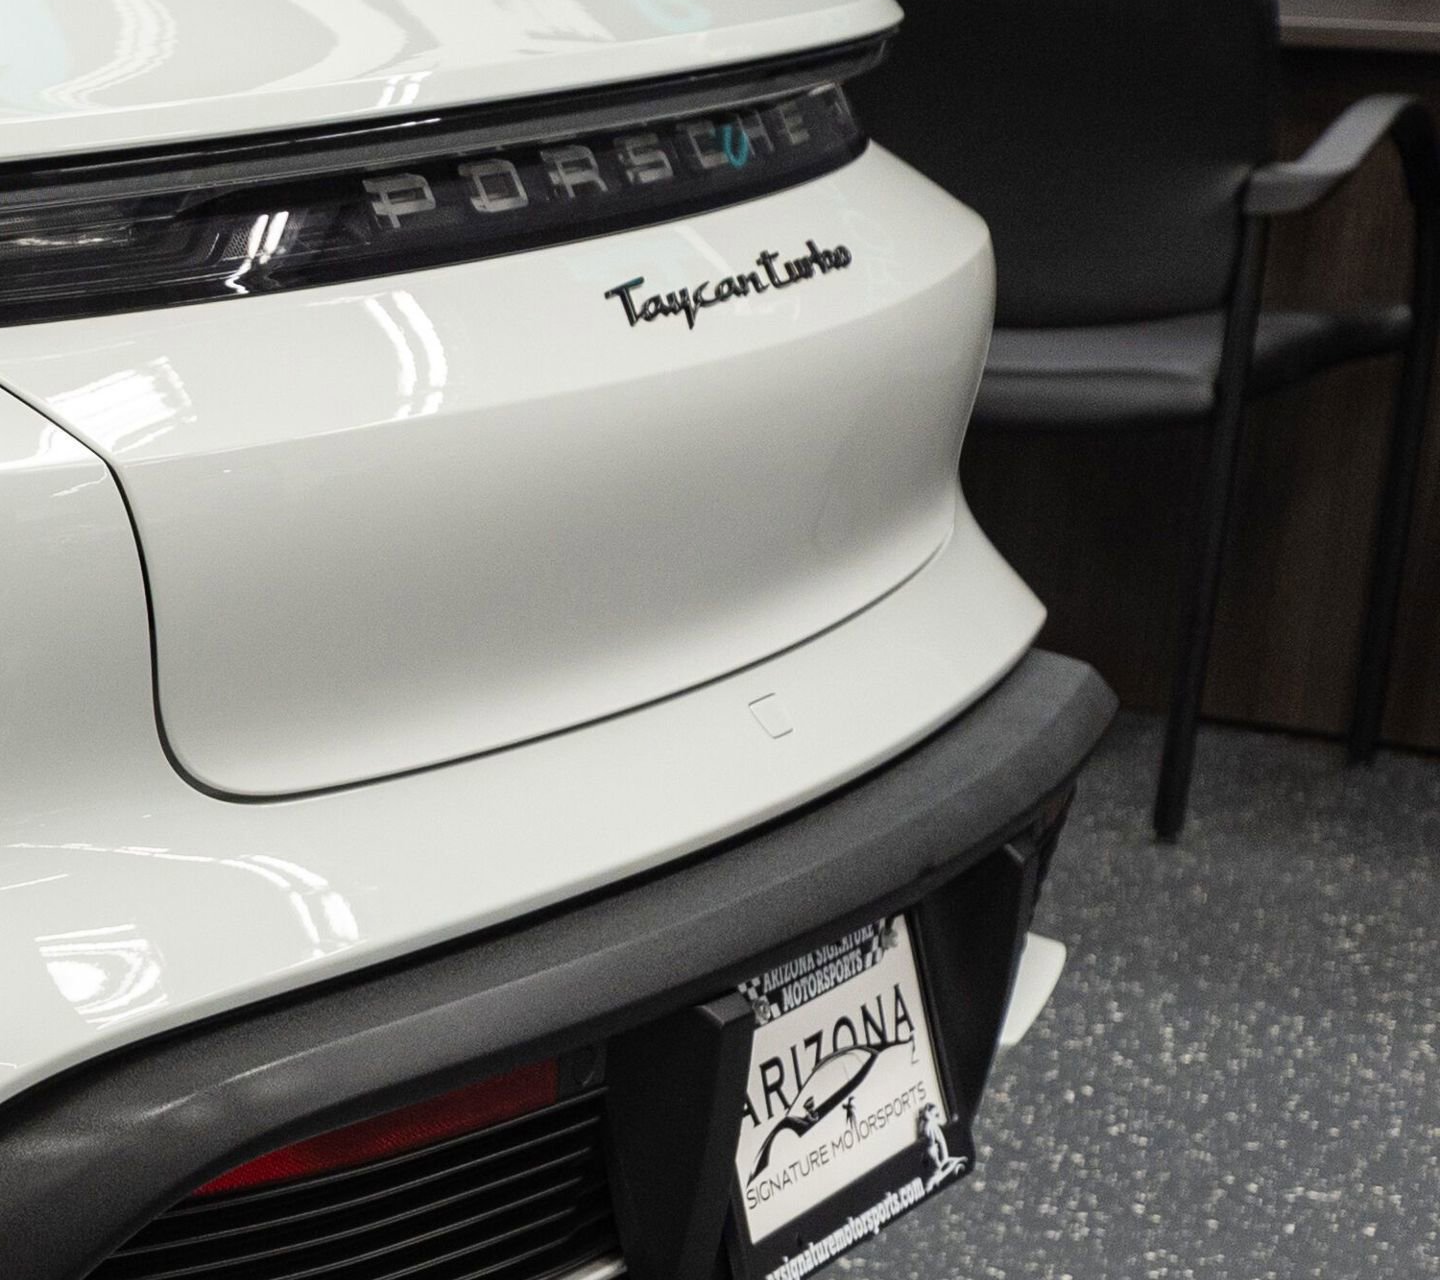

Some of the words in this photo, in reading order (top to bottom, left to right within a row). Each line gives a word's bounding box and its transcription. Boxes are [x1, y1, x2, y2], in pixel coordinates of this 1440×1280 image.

[362, 98, 811, 229] PORSCHE
[764, 952, 816, 993] ARIZONA
[782, 948, 864, 1012] MOTORSPORTS
[746, 1144, 832, 1210] SIGNATURE
[830, 1080, 927, 1158] MOTORSPORTS
